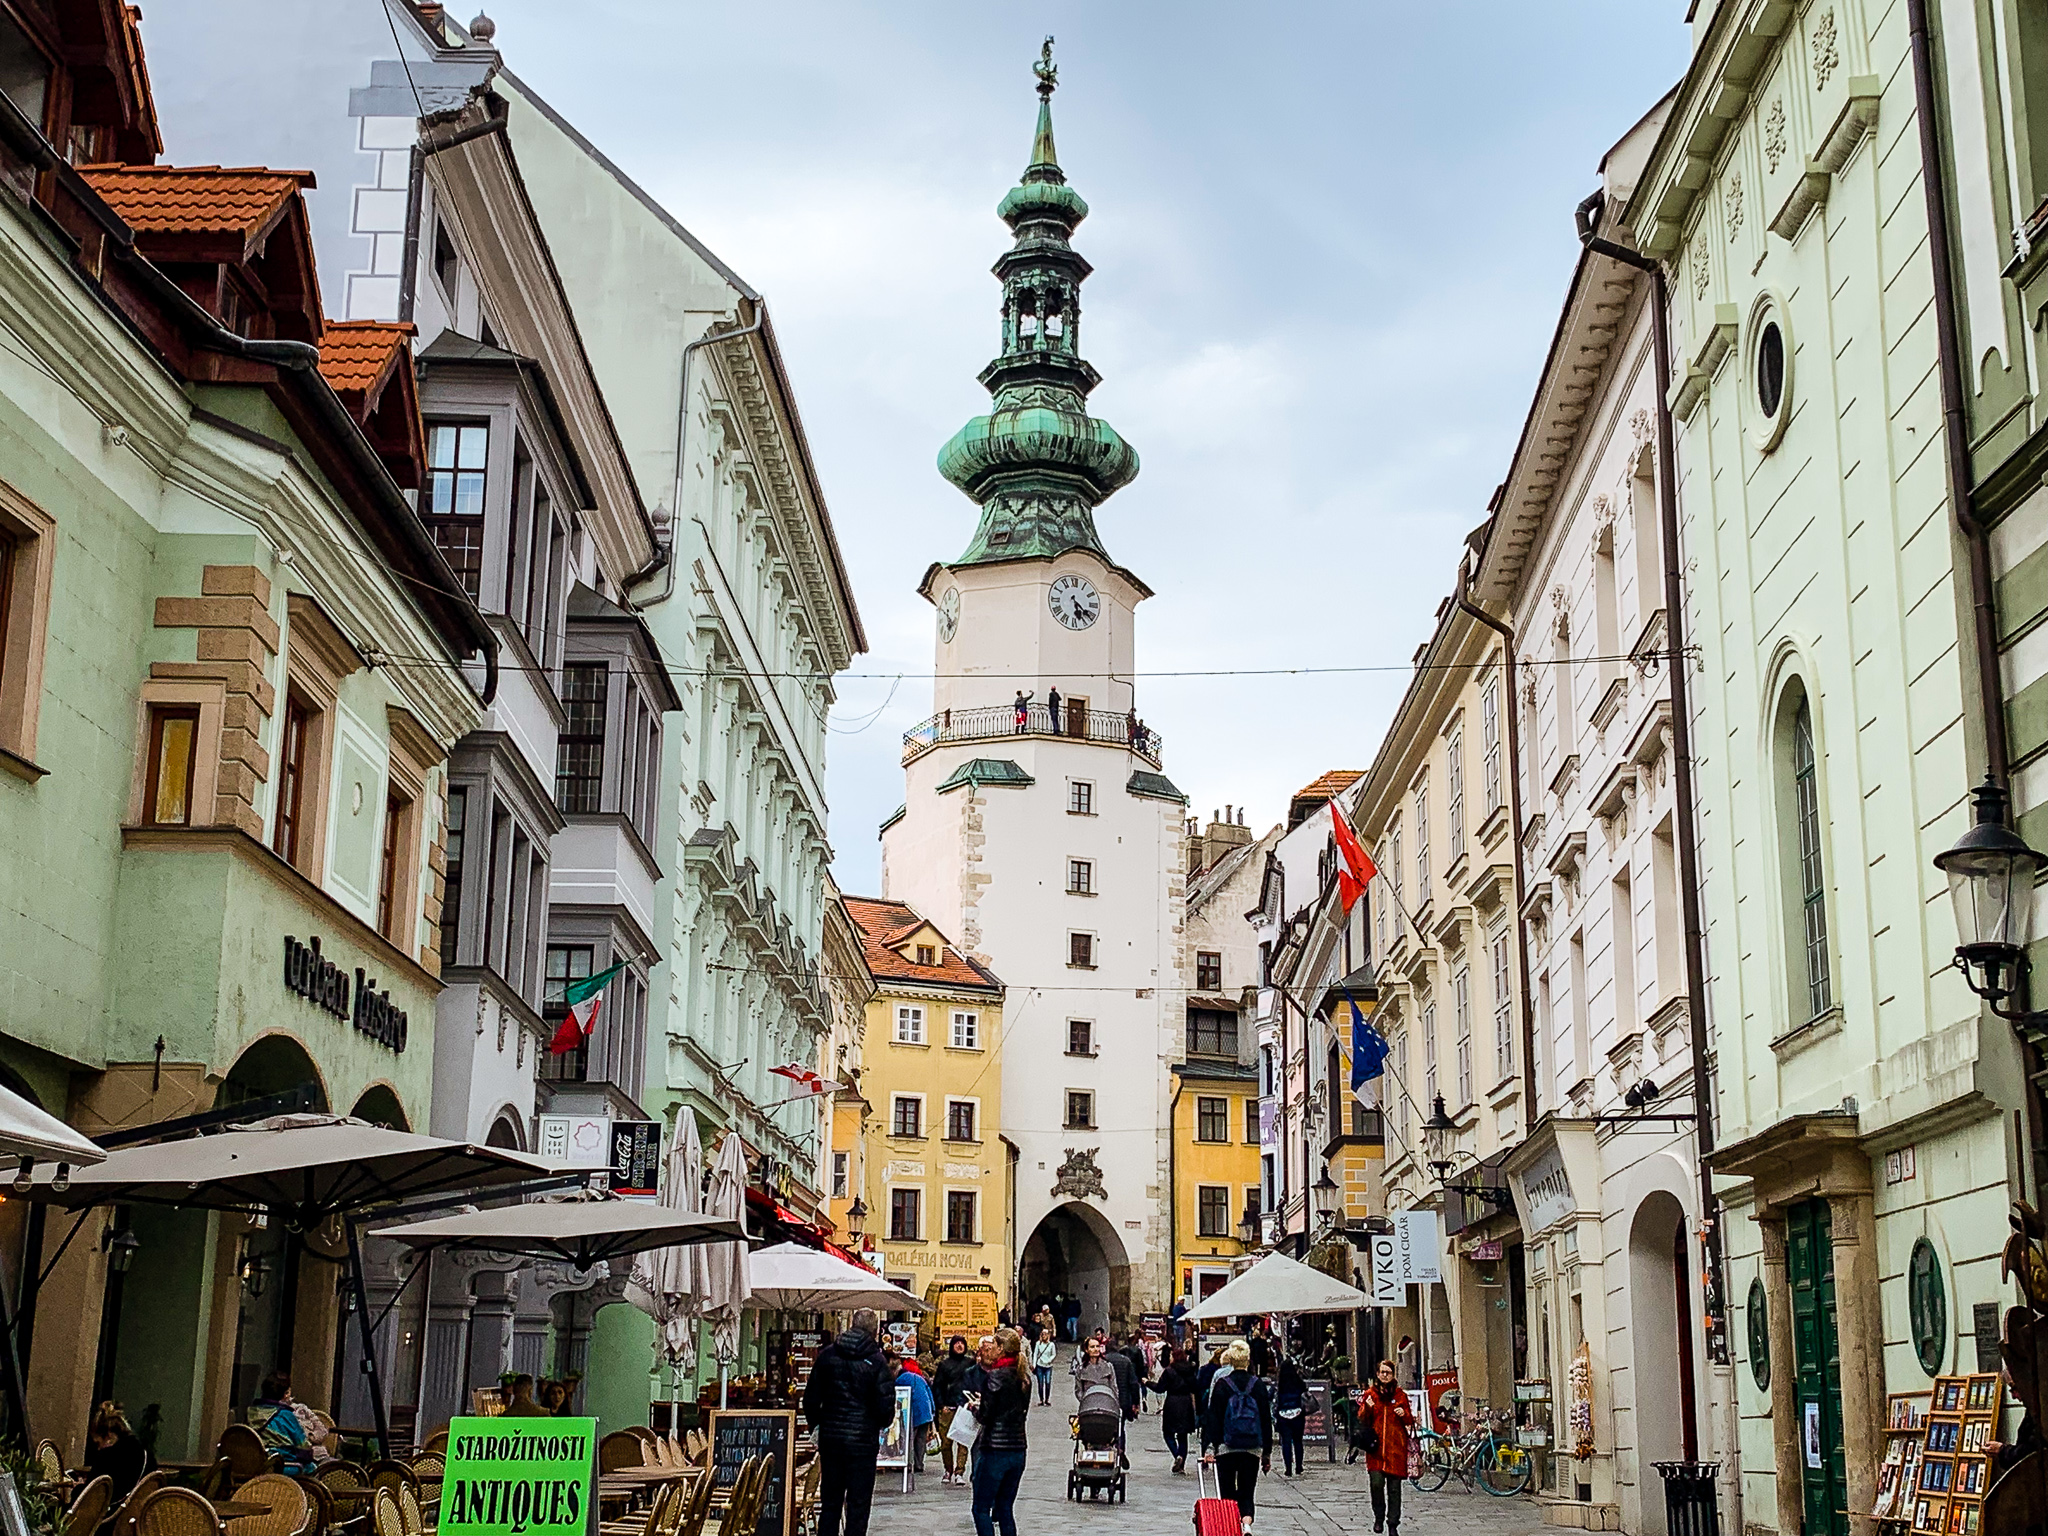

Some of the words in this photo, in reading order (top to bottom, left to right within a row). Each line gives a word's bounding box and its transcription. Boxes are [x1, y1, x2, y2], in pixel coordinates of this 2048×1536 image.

[284, 935, 350, 1020] urban
[353, 967, 408, 1054] bistro
[1398, 1215, 1410, 1251] CIGÁR
[886, 1248, 937, 1268] GALÉRIA
[939, 1253, 973, 1269] NOVA
[1376, 1240, 1395, 1301] IVKO
[1402, 1253, 1412, 1279] DOM
[1432, 1377, 1450, 1386] DOM
[454, 1429, 586, 1461] STAROŽITNOSTI
[448, 1480, 581, 1533] ANTIQUES
